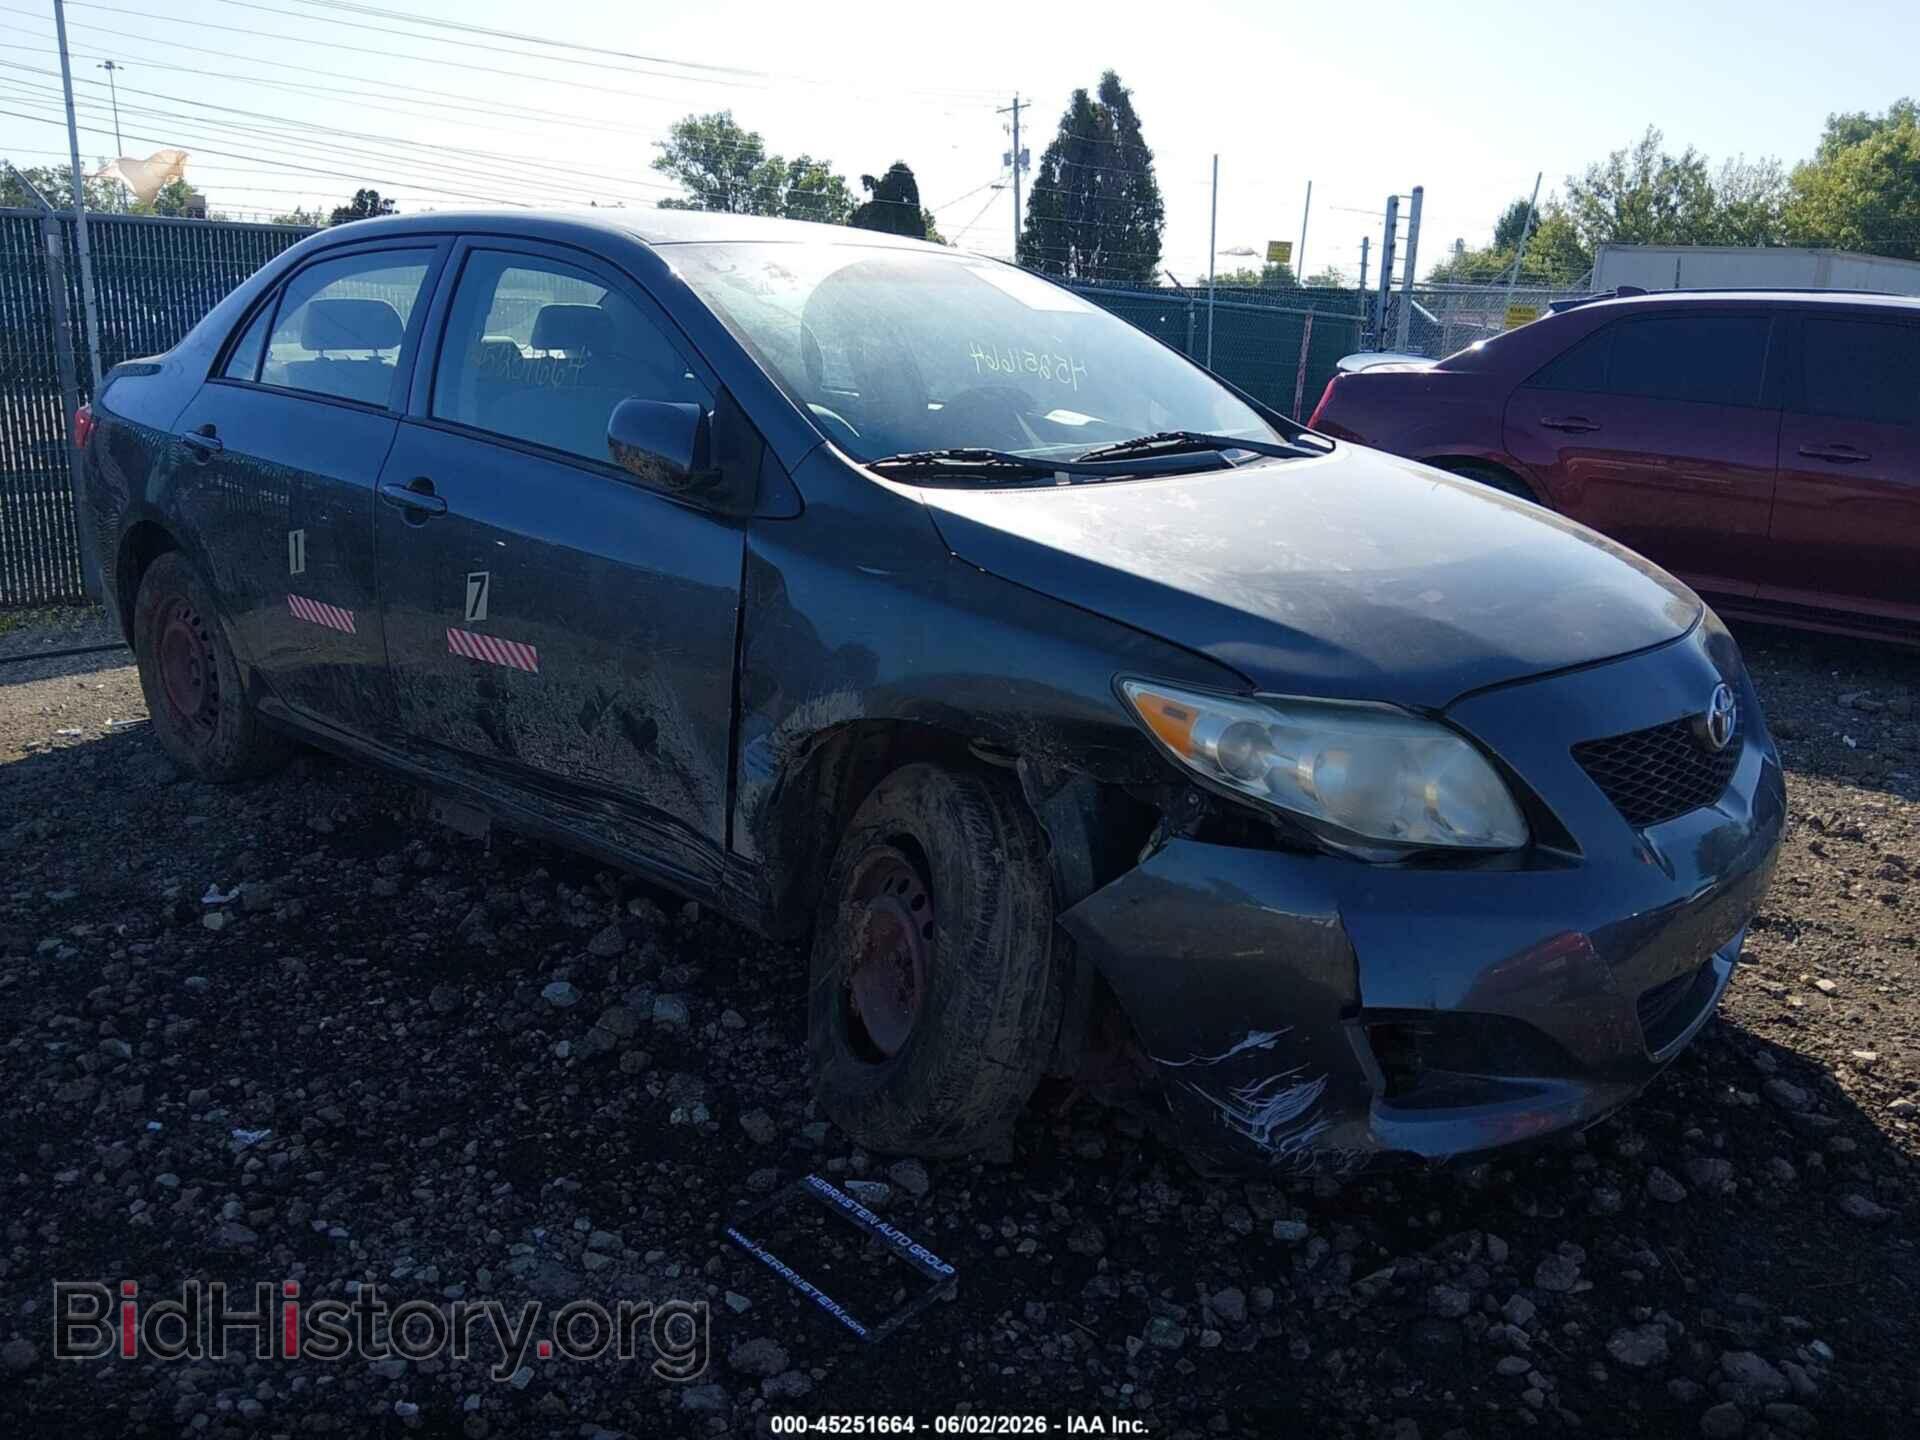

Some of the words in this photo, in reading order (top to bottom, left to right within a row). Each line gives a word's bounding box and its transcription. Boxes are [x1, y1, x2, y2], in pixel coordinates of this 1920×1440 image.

[472, 343, 591, 387] 5251664
[469, 575, 487, 618] 7
[877, 1222, 912, 1247] AUTO
[908, 1243, 956, 1275] GROUP
